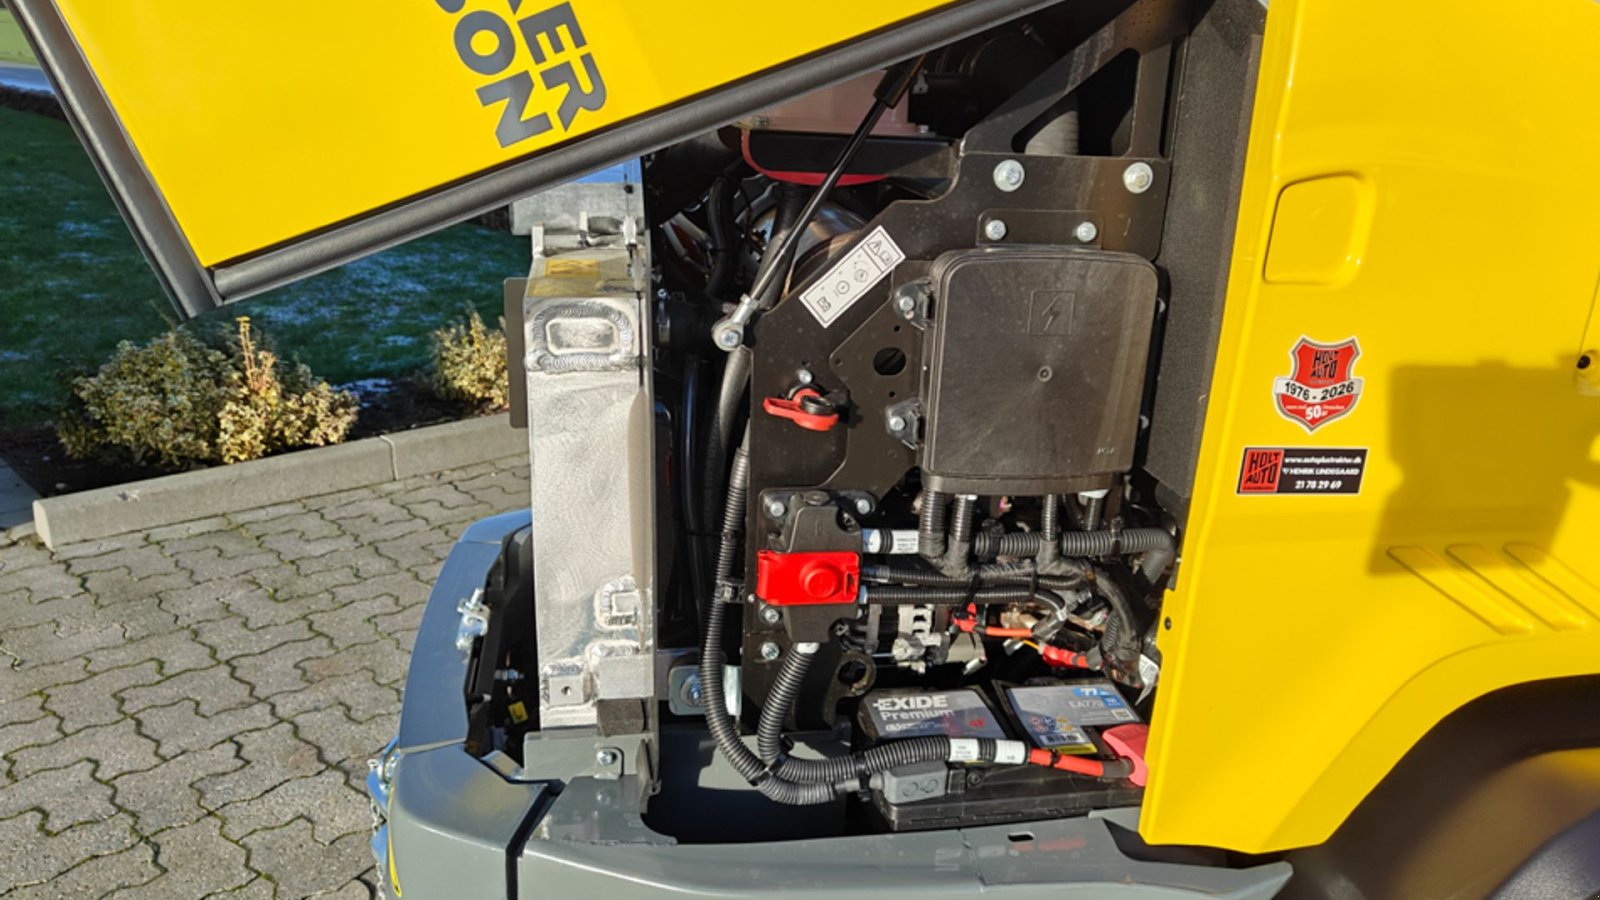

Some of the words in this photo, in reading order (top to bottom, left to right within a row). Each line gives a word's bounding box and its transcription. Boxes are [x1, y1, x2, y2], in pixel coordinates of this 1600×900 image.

[435, 0, 553, 148] ON
[507, 0, 607, 133] ER
[1312, 350, 1339, 368] HOLT
[1310, 360, 1338, 379] AUTO
[1285, 381, 1310, 401] 1976
[1320, 381, 1355, 401] 2026
[1305, 405, 1322, 420] 50
[1248, 452, 1280, 473] HOLT
[1244, 462, 1278, 484] AUTO
[1295, 480, 1305, 489] 21
[1318, 480, 1330, 489] 29
[1330, 480, 1342, 489] 69
[874, 695, 949, 711] EXIDE
[880, 708, 955, 721] Premium
